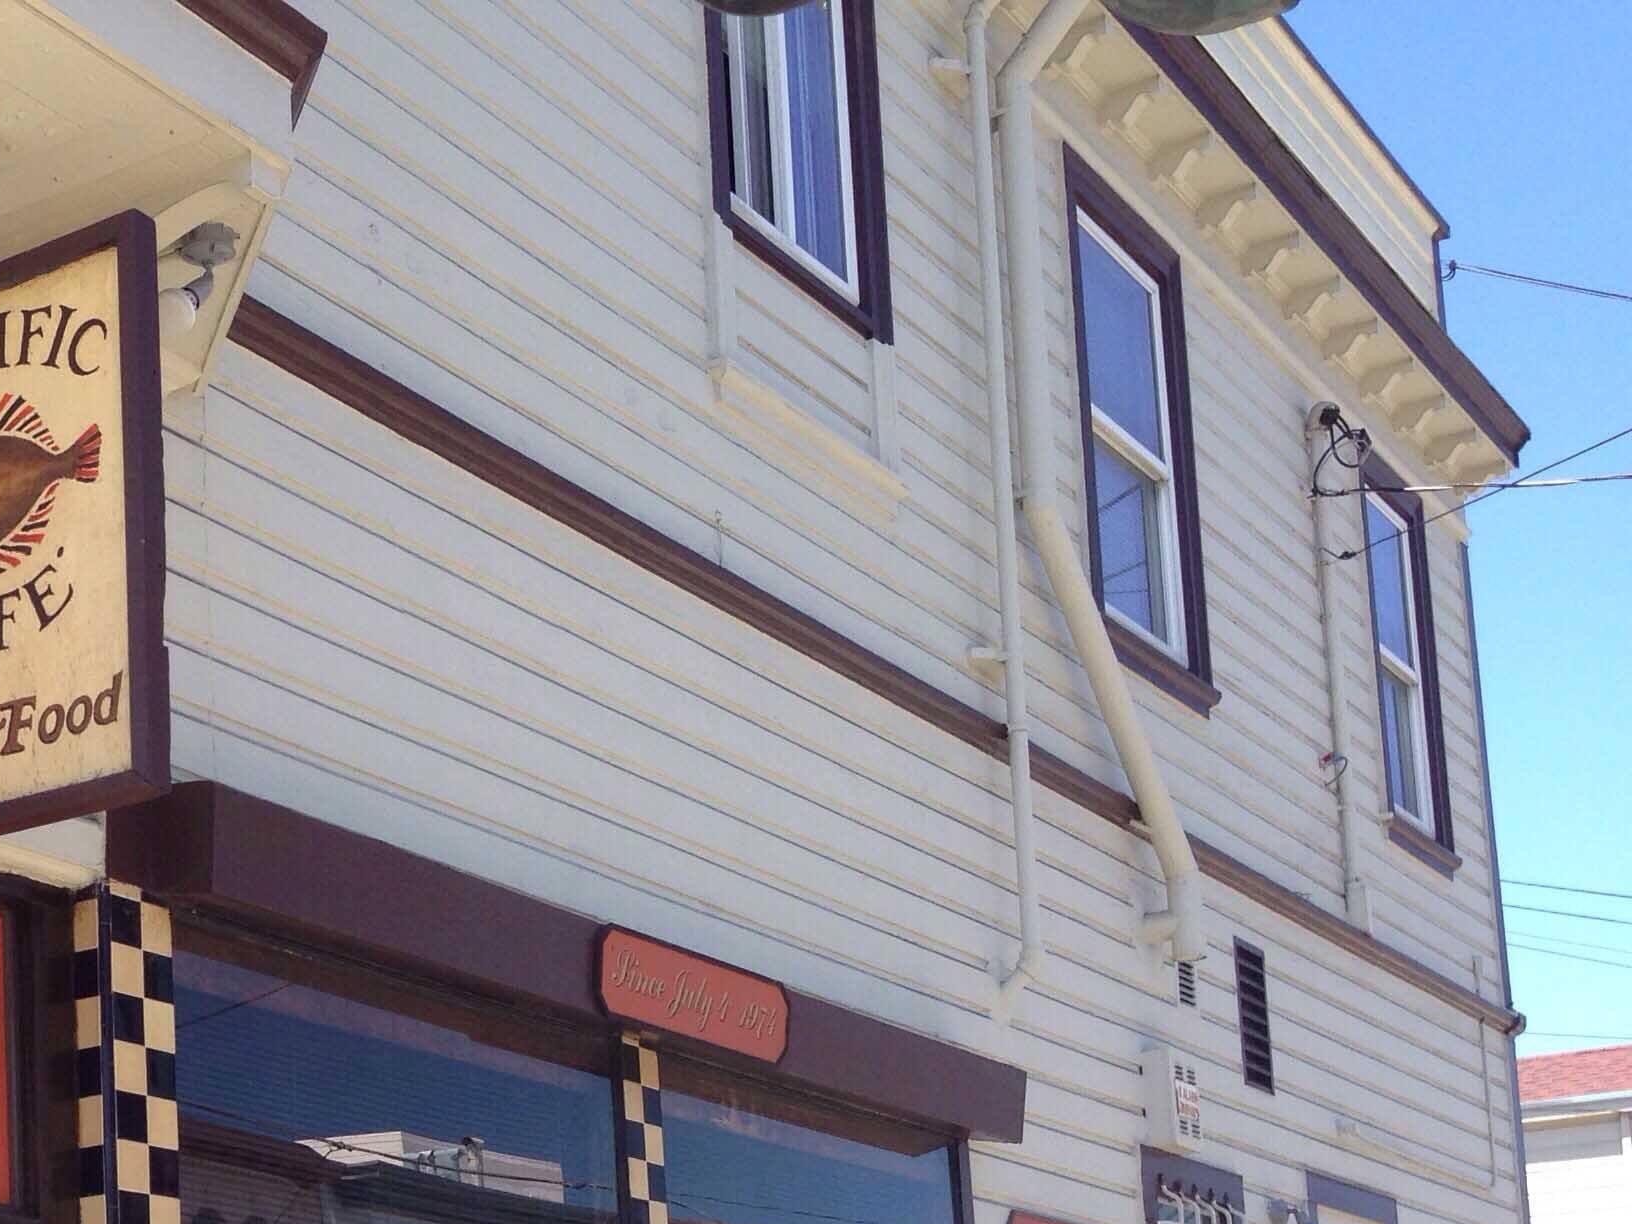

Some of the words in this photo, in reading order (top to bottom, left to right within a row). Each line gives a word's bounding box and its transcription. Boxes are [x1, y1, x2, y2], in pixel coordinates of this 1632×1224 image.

[612, 950, 665, 997] Since
[667, 969, 713, 1032] July
[739, 1001, 777, 1040] 1974
